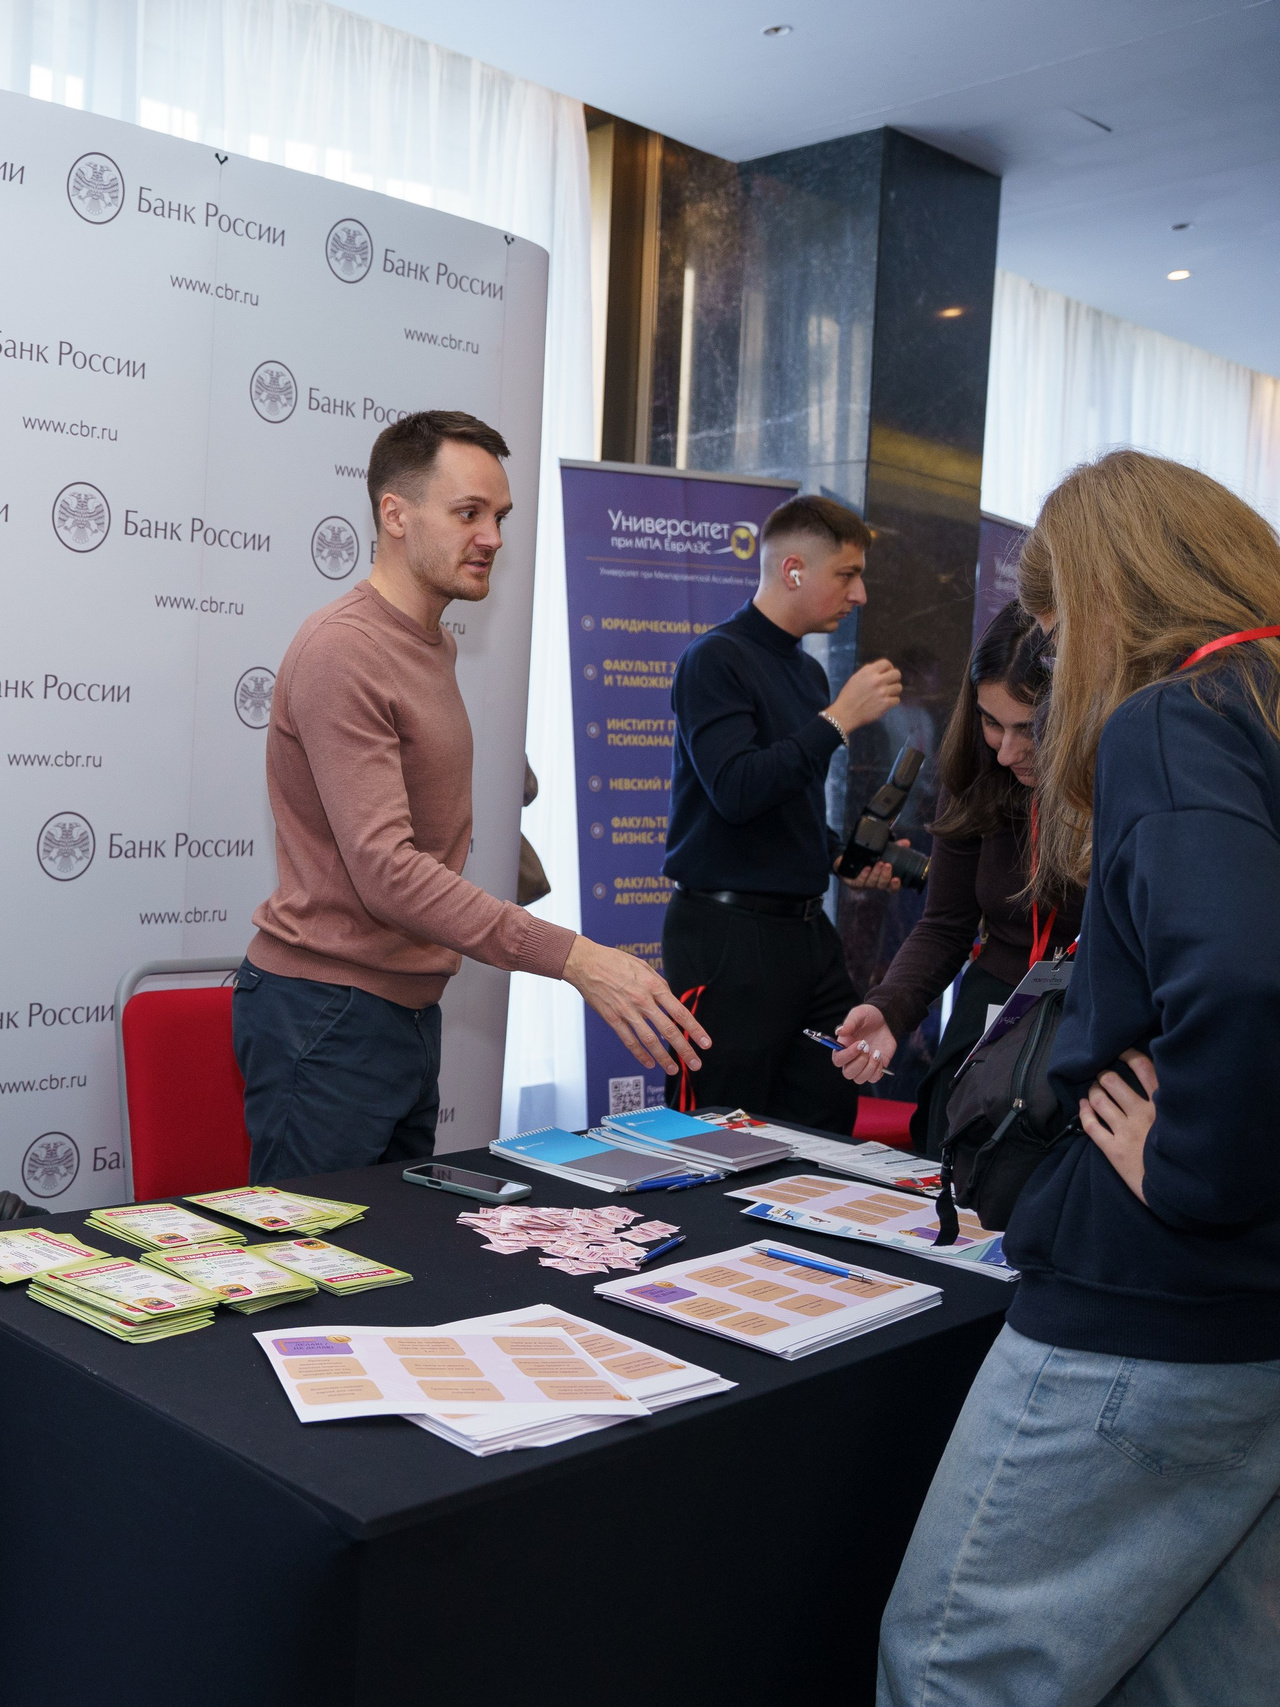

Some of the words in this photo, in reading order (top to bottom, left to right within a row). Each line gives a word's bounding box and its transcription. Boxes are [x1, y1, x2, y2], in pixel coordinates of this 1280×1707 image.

[137, 186, 196, 225] Банк
[205, 202, 286, 247] России
[382, 248, 430, 284] Банк
[435, 262, 505, 302] России
[169, 274, 260, 307] www.cbr.ru
[403, 327, 480, 355] www.cbr.ru
[58, 340, 147, 381] России
[308, 386, 357, 419] Банк
[22, 416, 119, 442] www.cbr.ru
[124, 509, 182, 542] Банк
[190, 517, 271, 553] России
[607, 508, 730, 540] Университет
[610, 536, 633, 550] при
[634, 537, 662, 550] МПА
[154, 594, 244, 617] www.cbr.ru
[601, 617, 691, 634] ЮРИДИЧЕСКИЙ
[602, 659, 667, 674] ФАКУЛЬТЕТ
[43, 674, 131, 703] России
[604, 674, 613, 687] И
[616, 675, 673, 689] ТАМОЖЕН
[607, 718, 664, 732] ИНСТИТУТ
[7, 750, 103, 769] www.cbr.ru
[609, 776, 661, 791] НЕВСКИЙ
[611, 816, 668, 829] ФАКУЛЬТЕ
[108, 833, 167, 859] Банк
[174, 832, 255, 859] России
[612, 831, 666, 844] БИЗНЕС-К
[139, 906, 228, 926] www.cbr.ru
[28, 1002, 115, 1031] России
[92, 1146, 125, 1172] Ба
